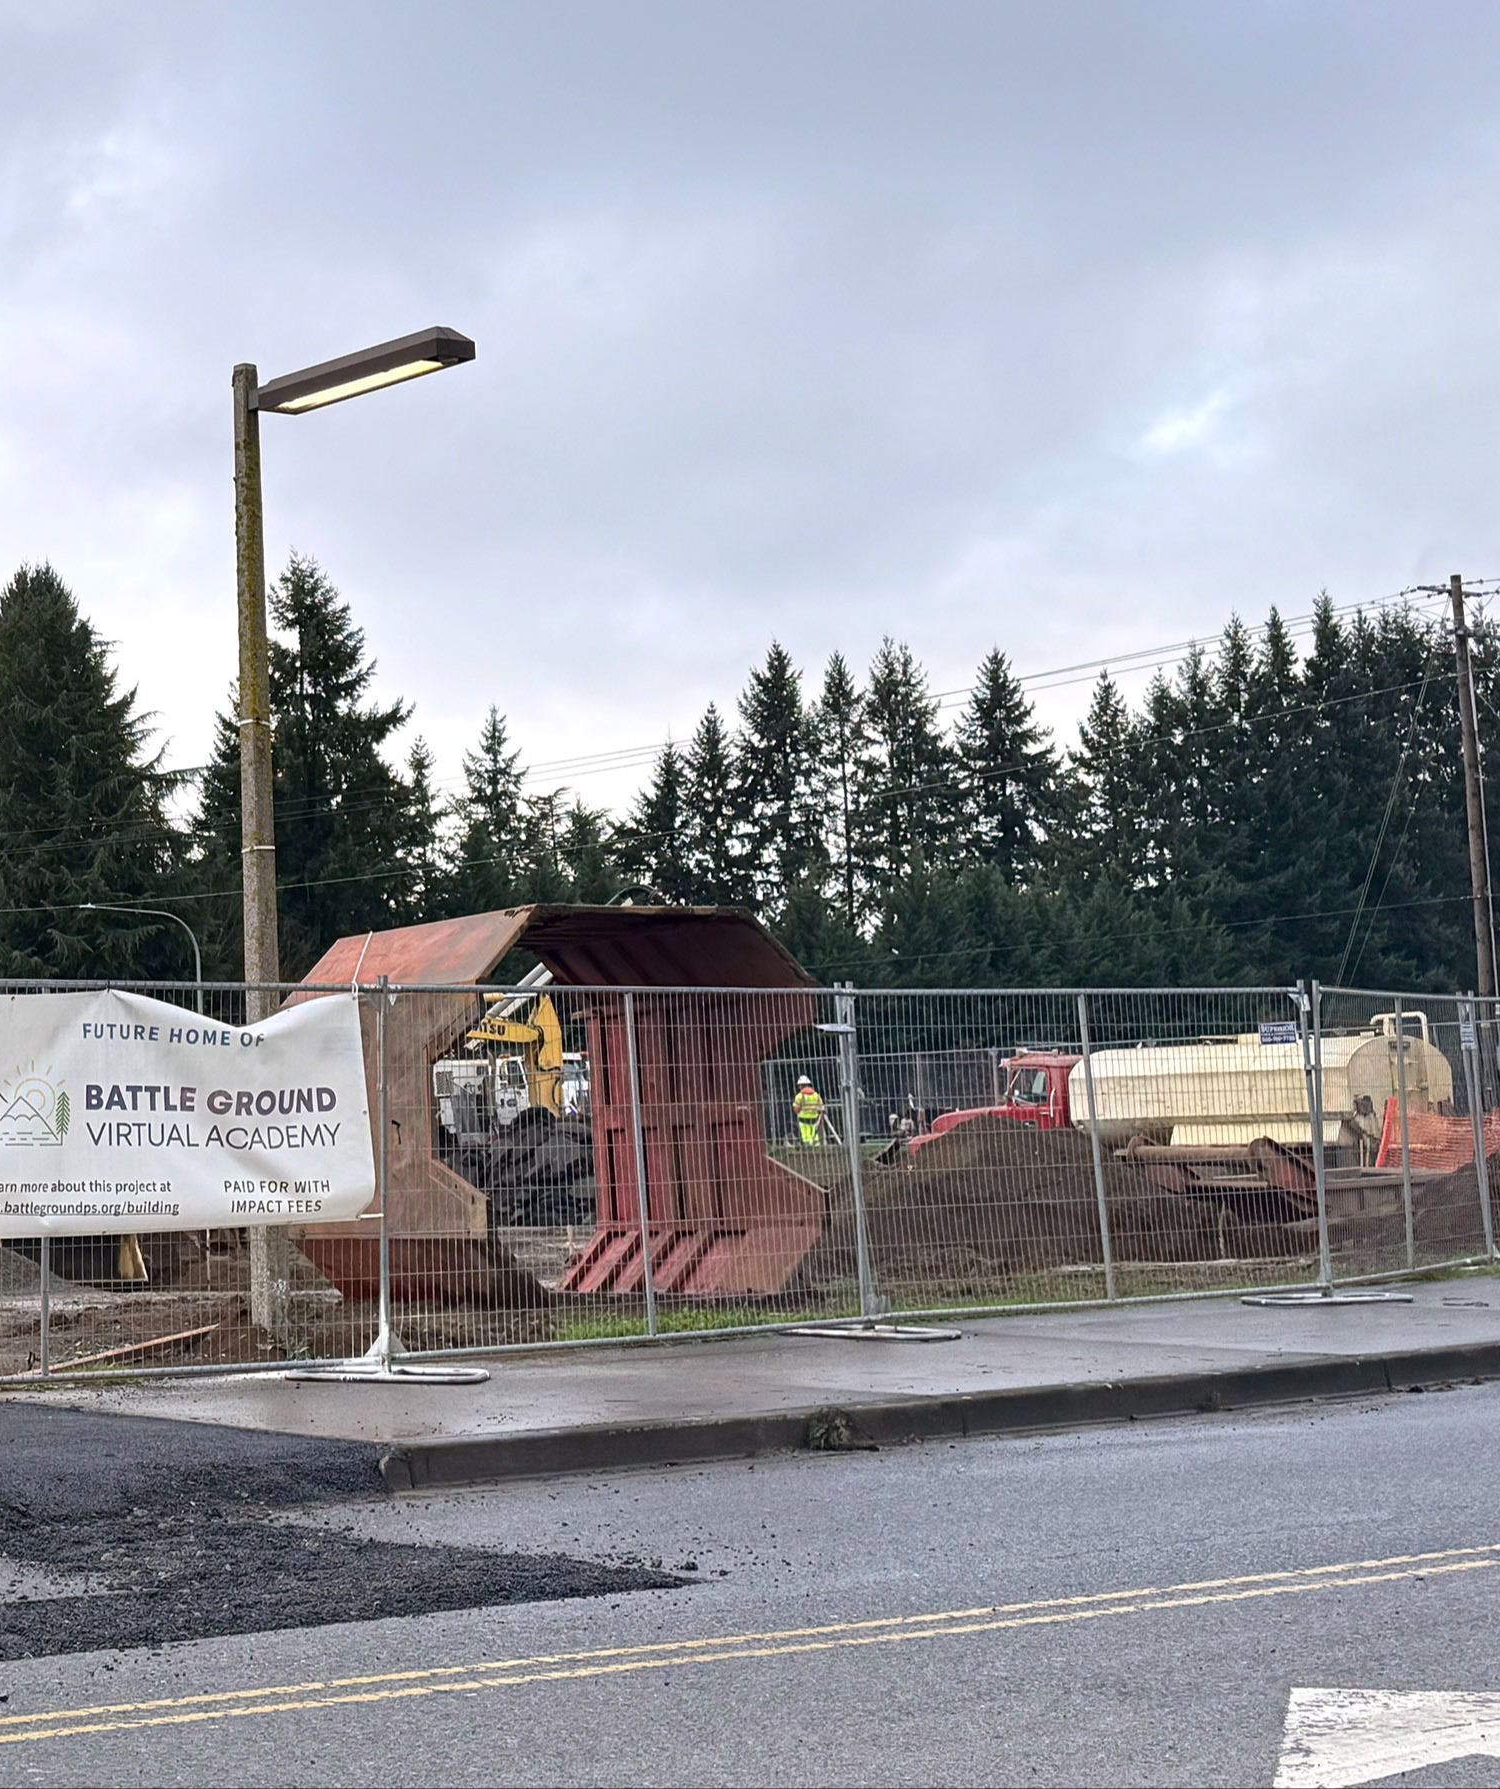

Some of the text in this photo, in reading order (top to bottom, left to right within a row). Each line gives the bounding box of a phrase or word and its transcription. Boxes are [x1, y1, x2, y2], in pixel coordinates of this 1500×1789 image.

[82, 1022, 266, 1048] FUTURE HOME OF
[85, 1084, 338, 1116] BATTLE GROUND
[85, 1122, 341, 1150] VIRTUAL ACADEMY
[20, 1183, 49, 1193] more
[50, 1179, 86, 1193] about
[89, 1179, 112, 1193] this
[115, 1179, 156, 1195] project
[160, 1180, 172, 1193] at
[223, 1179, 331, 1193] PAID FOR WITH
[230, 1199, 323, 1213] IMPACT FEES
